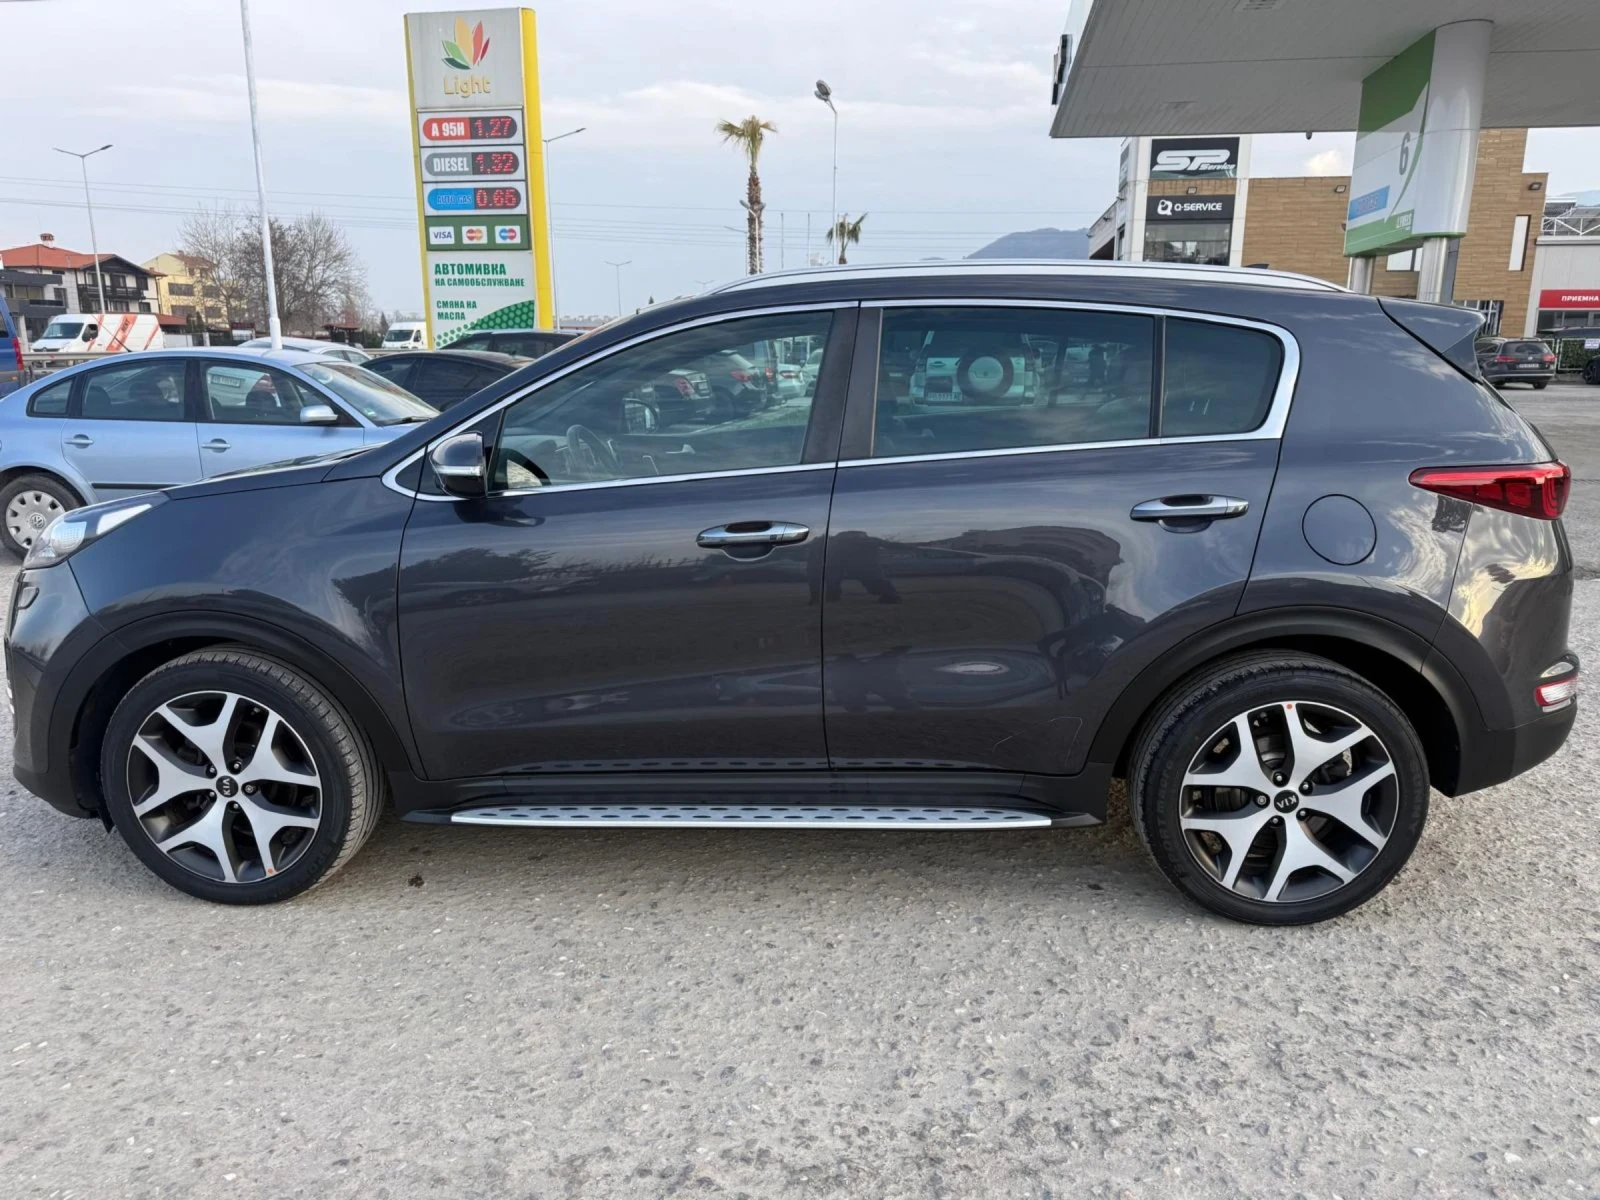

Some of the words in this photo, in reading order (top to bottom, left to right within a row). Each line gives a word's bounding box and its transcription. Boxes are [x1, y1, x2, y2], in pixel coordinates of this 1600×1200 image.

[443, 75, 491, 98] Light
[431, 122, 440, 137] A
[1152, 149, 1231, 171] SP
[1398, 131, 1411, 175] 6
[433, 157, 469, 172] DIESEL
[433, 231, 453, 239] VISA
[434, 263, 507, 275] АВТОМИВКА
[435, 278, 446, 287] НА
[447, 278, 525, 287] САМООБСЛУЖВАНЕ
[436, 300, 465, 309] СМЯНА
[466, 300, 478, 309] НА
[437, 312, 466, 320] МАСЛА
[222, 778, 231, 796] KIA
[1276, 795, 1297, 808] KIA
